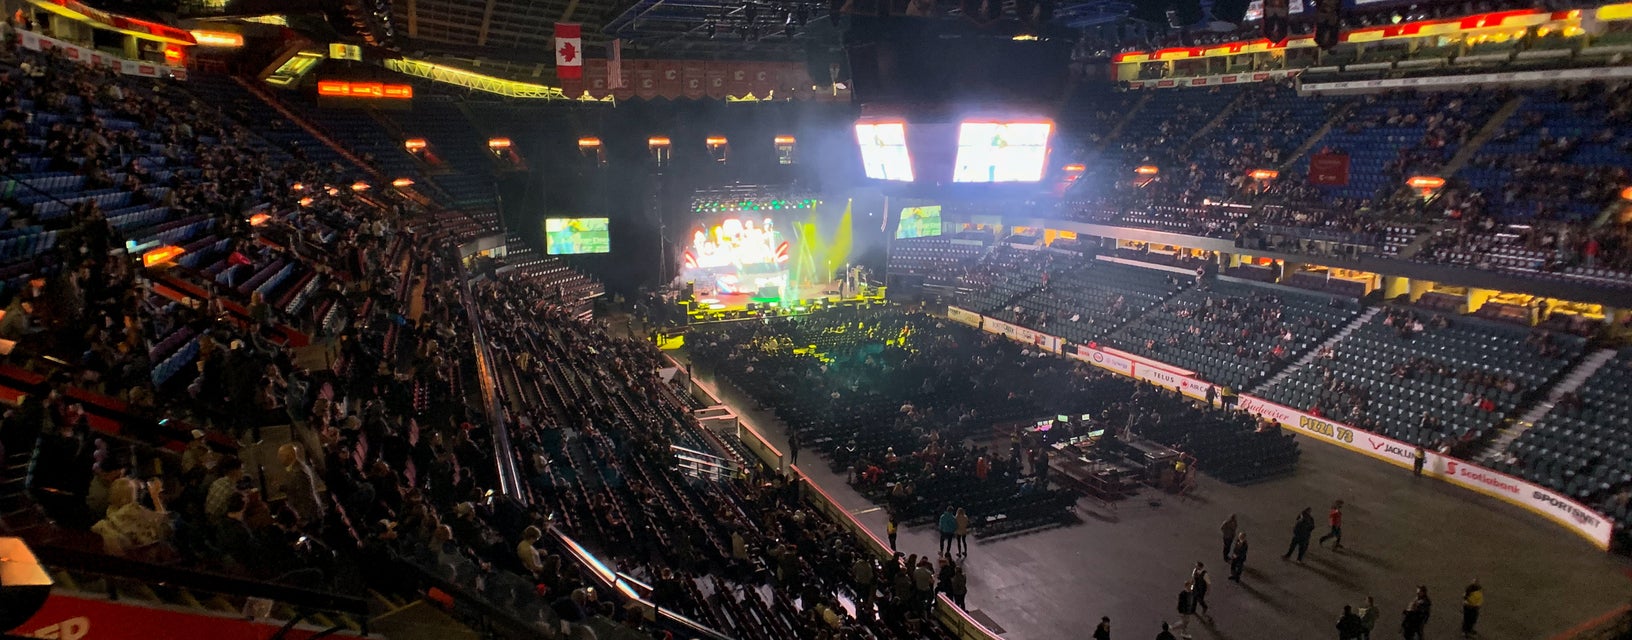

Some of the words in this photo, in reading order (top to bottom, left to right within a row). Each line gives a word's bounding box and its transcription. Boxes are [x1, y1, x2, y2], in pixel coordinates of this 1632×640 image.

[1153, 371, 1175, 383] TELUS
[1189, 383, 1200, 391] AIR
[1239, 398, 1290, 421] Budweiser
[1300, 415, 1334, 437] PIZZA
[1337, 426, 1354, 444] 73
[1461, 468, 1520, 494] Scotiabank
[1532, 490, 1601, 528] SPORTSNET
